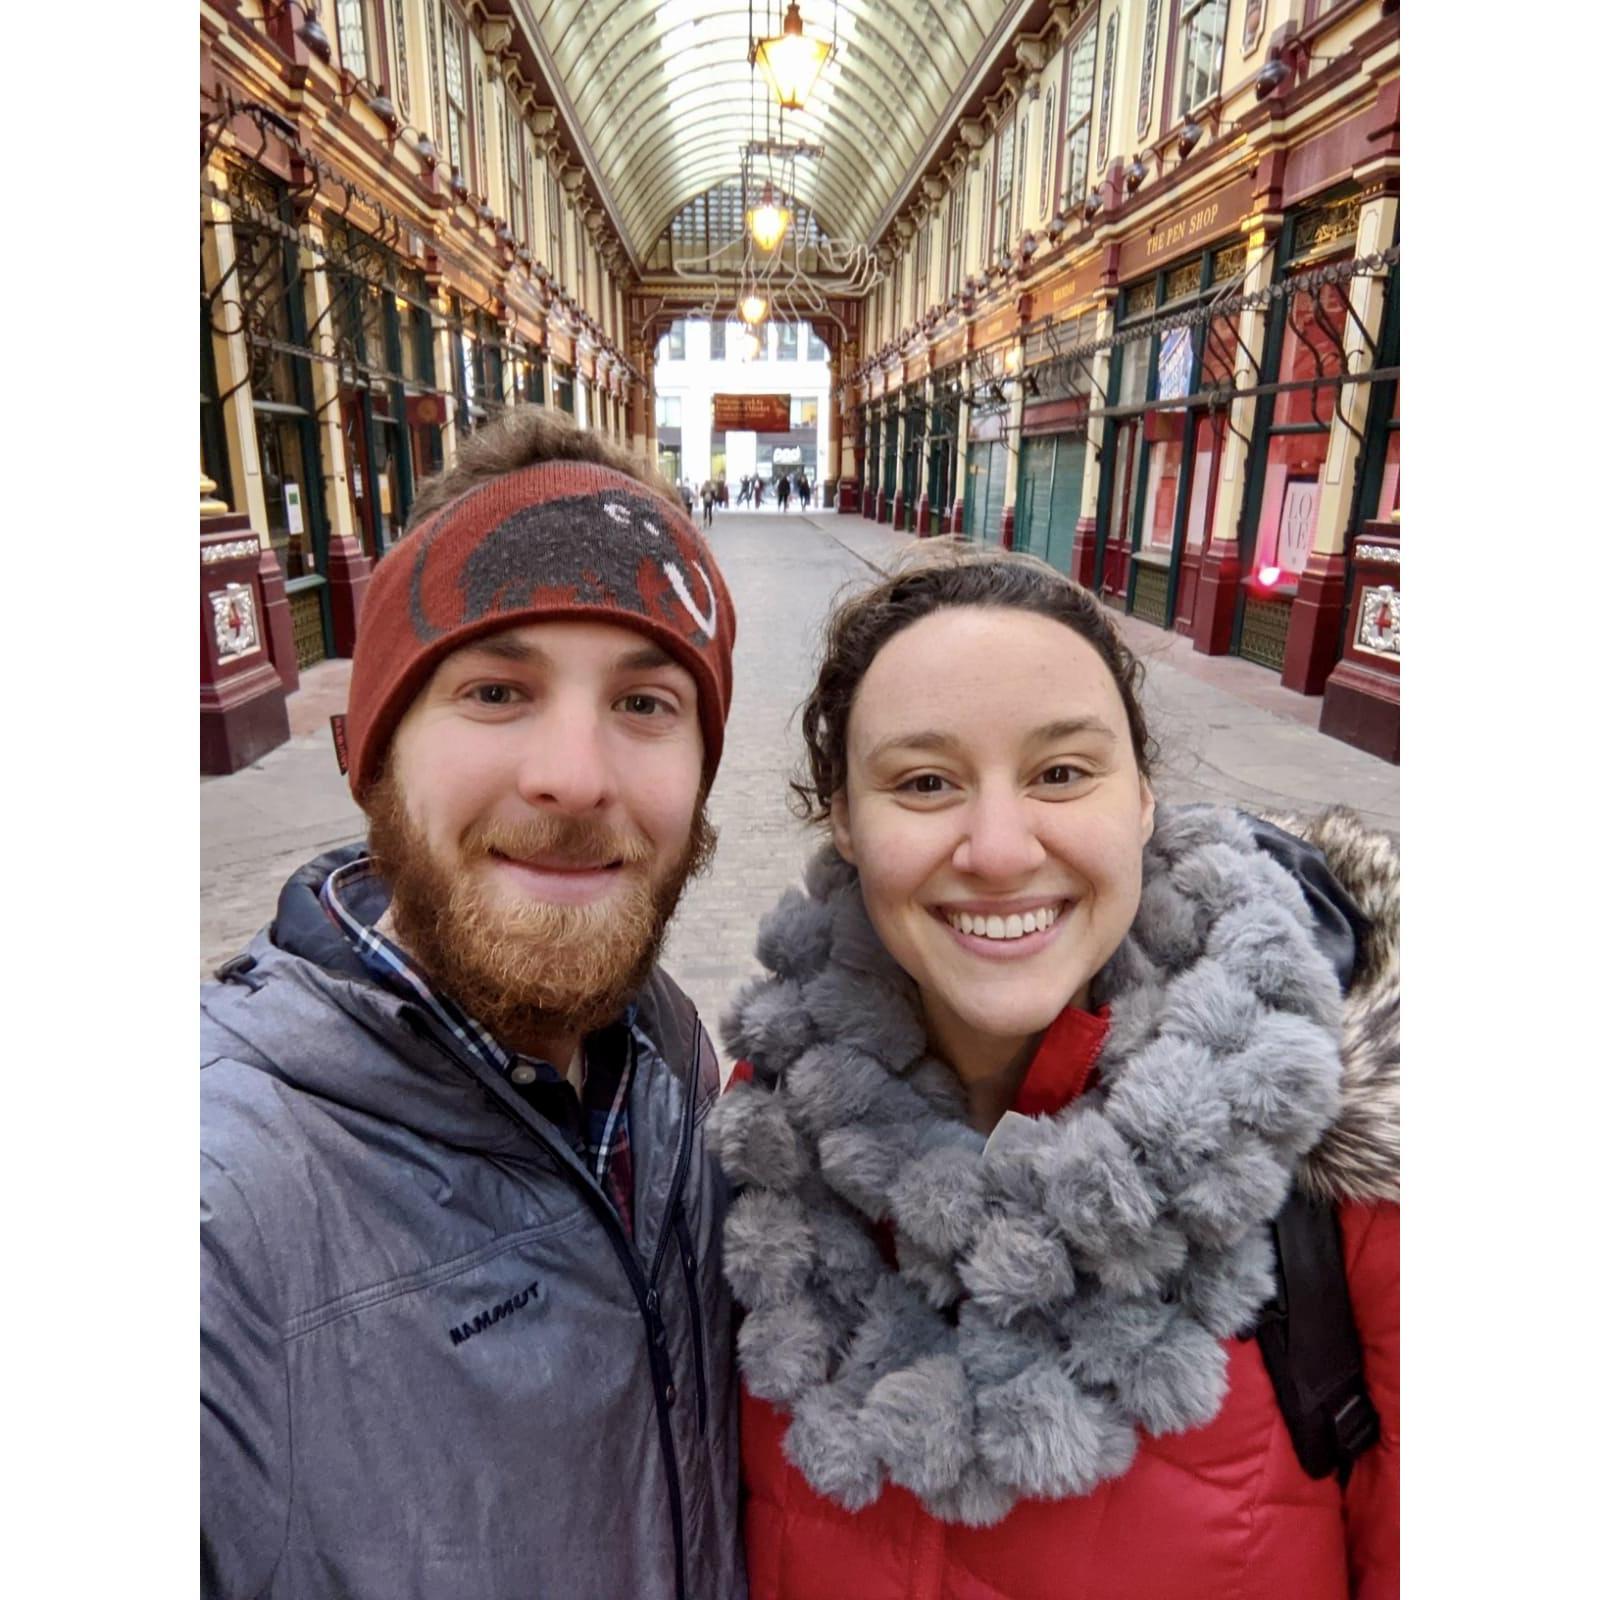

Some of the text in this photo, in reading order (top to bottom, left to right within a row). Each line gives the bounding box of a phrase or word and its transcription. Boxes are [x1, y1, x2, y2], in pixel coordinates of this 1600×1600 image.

[1147, 203, 1218, 256] THE PEN SHOP
[449, 1281, 538, 1346] MAMMUT
